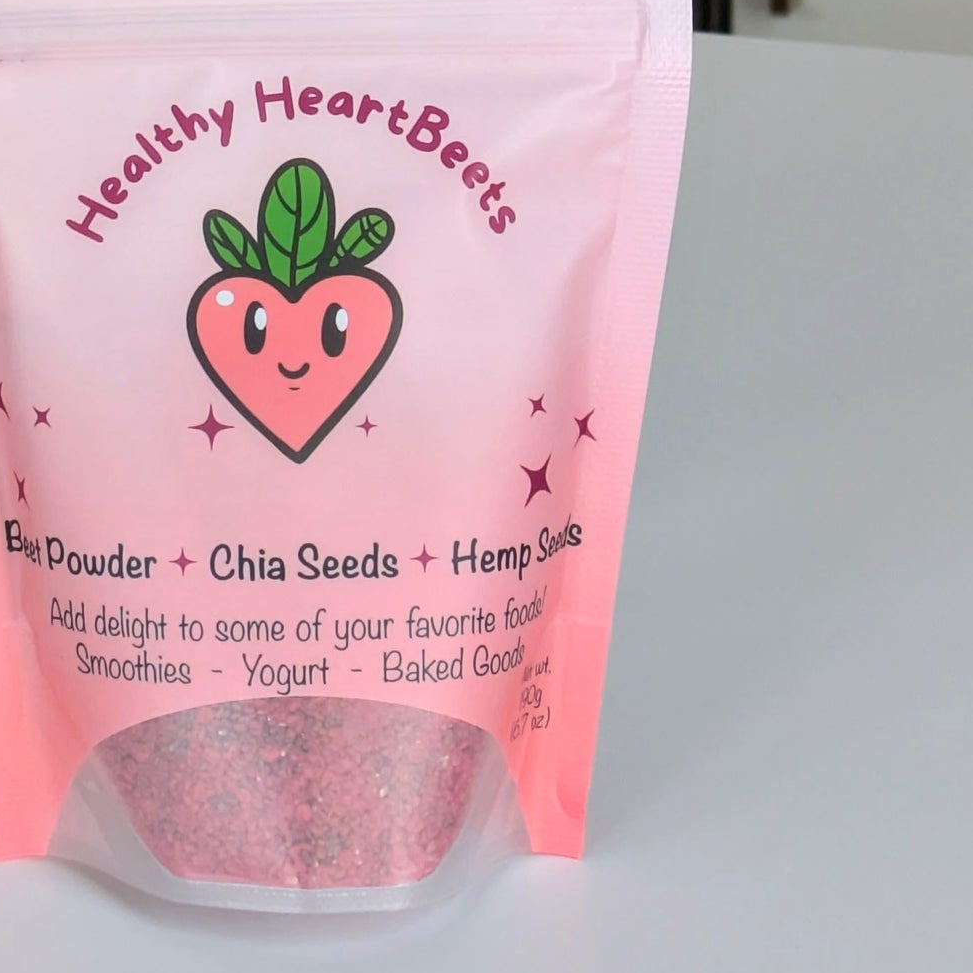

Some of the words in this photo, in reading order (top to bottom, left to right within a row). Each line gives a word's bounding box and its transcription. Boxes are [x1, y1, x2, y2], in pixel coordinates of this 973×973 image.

[66, 100, 234, 243] Healthy
[255, 76, 516, 234] HeartBeets
[4, 519, 41, 567] Beet
[46, 536, 157, 579] Powder
[210, 544, 285, 581] Chia
[297, 542, 399, 580] Seeds
[452, 538, 531, 581] Hemp
[537, 513, 582, 562] Seeds
[51, 597, 86, 633] Add
[95, 605, 167, 648] delight
[179, 615, 203, 642] to
[215, 619, 285, 643] some
[296, 608, 326, 642] of
[334, 618, 393, 651] your
[406, 606, 495, 639] favorite
[504, 585, 547, 630] foods!
[75, 643, 191, 685] Smoothies
[242, 653, 329, 695] Yogurt
[383, 647, 463, 683] Baked
[473, 636, 525, 677] Goods
